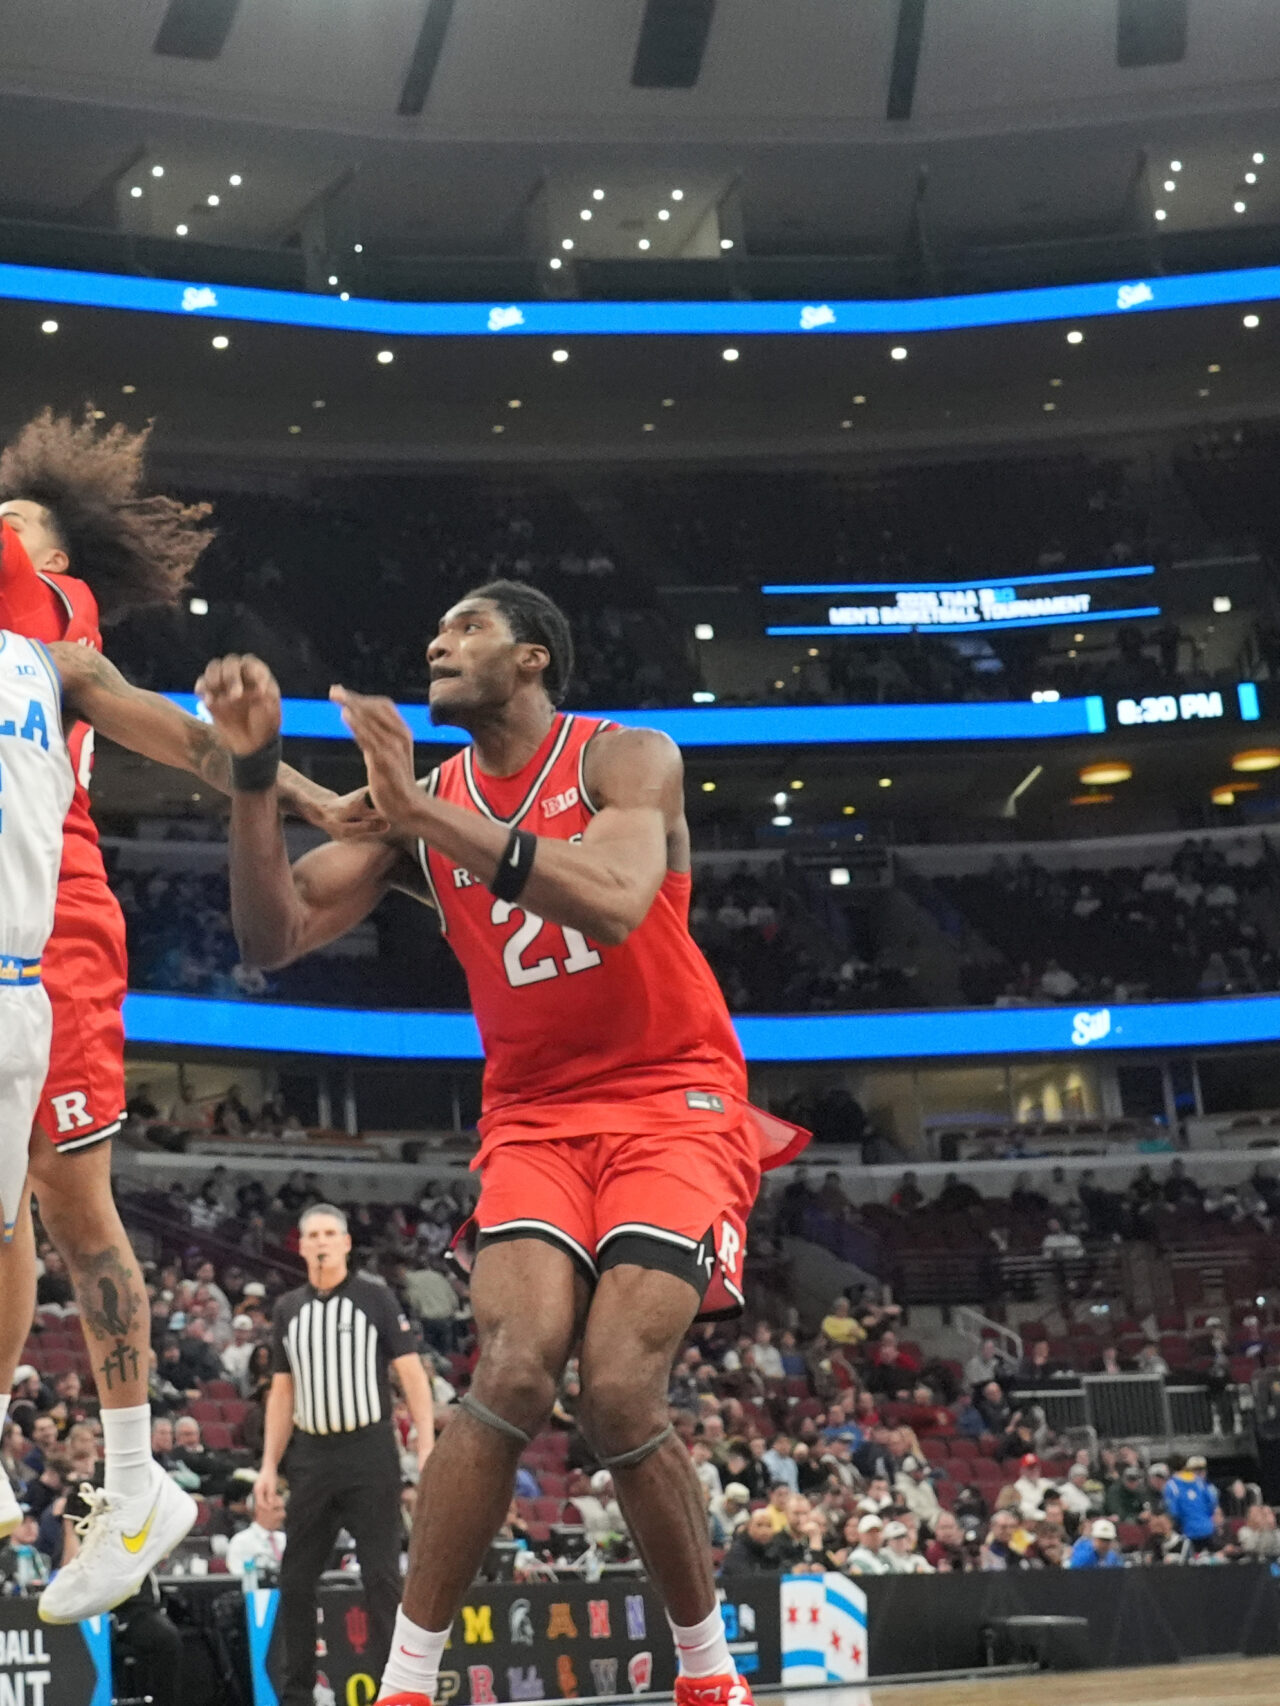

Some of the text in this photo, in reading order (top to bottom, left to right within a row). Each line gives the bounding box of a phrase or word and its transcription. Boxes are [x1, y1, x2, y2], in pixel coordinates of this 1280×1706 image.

[1179, 691, 1223, 719] PM
[490, 898, 603, 987] 21
[50, 1090, 94, 1133] R
[718, 1219, 741, 1274] R
[461, 1604, 495, 1645] M
[467, 1663, 498, 1705] R
